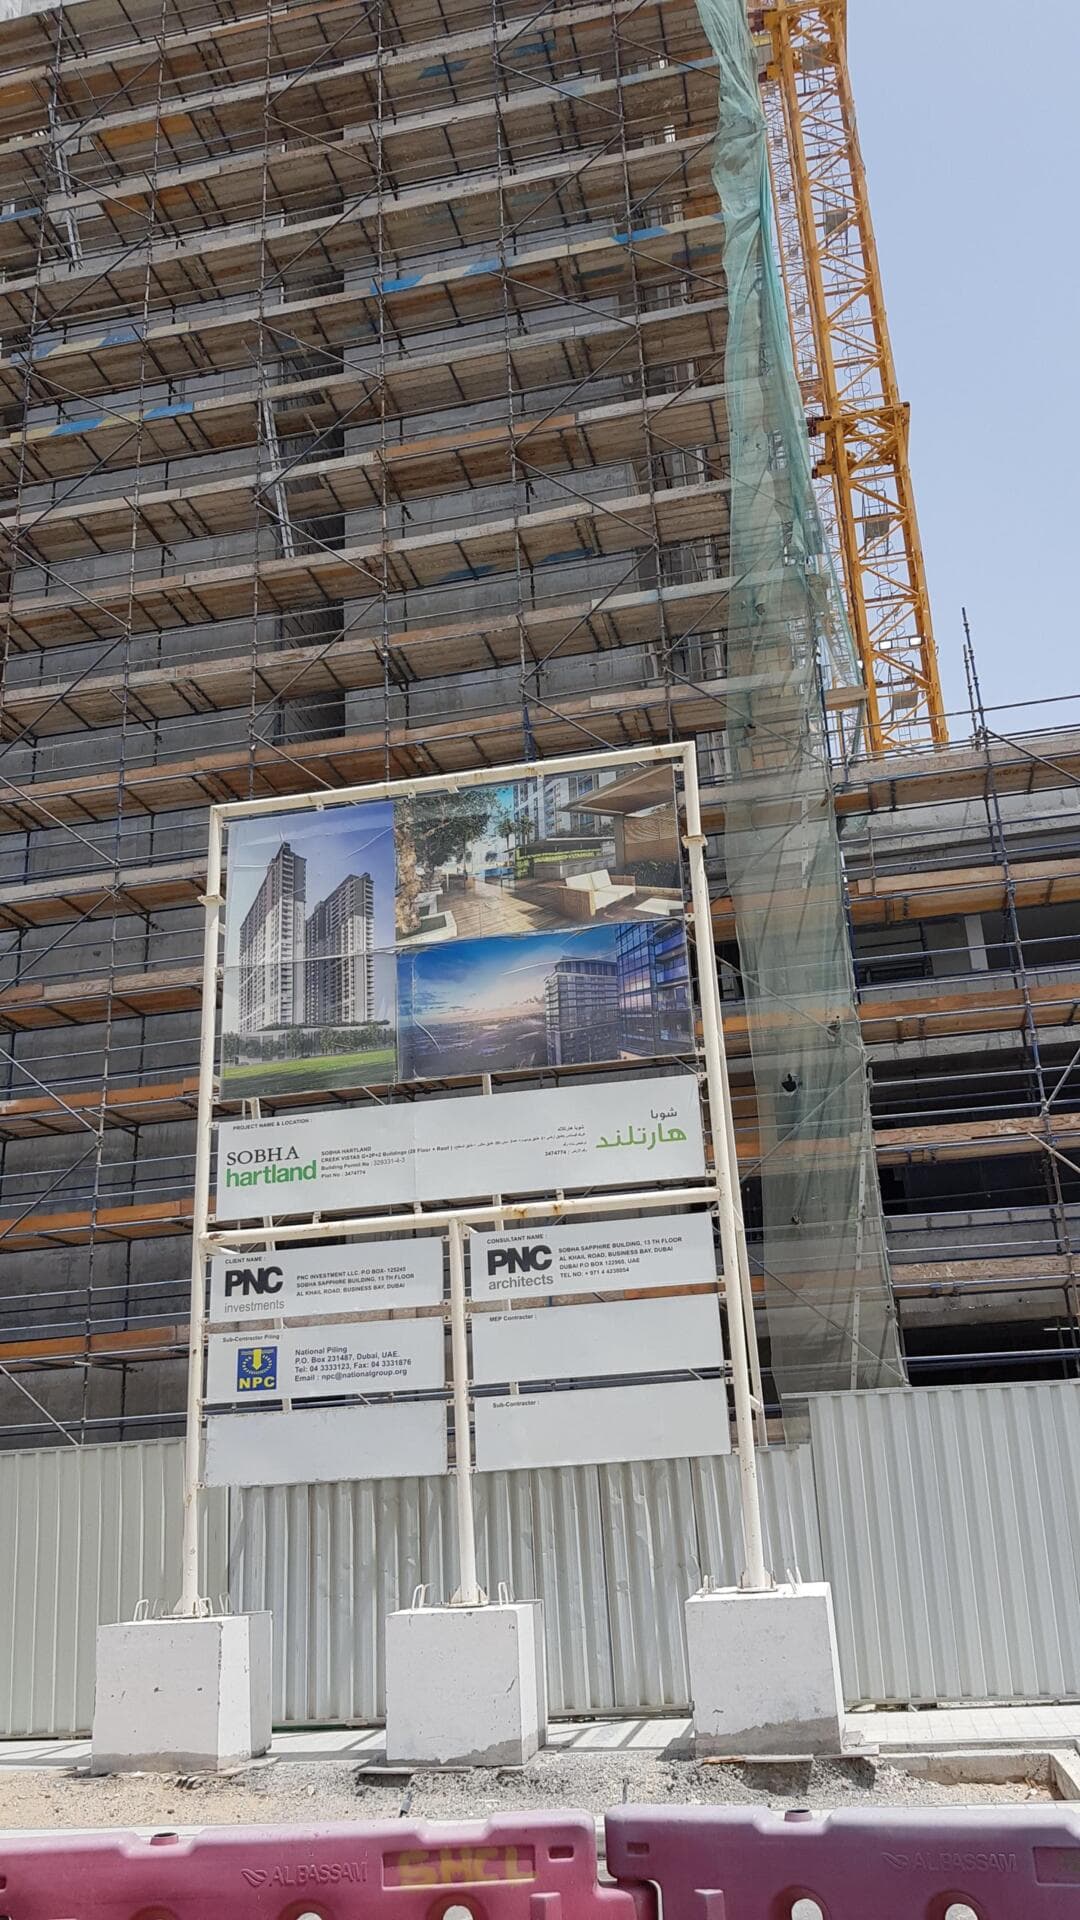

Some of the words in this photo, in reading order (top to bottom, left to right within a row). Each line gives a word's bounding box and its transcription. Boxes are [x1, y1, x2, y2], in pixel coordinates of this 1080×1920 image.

[227, 1146, 300, 1166] SOBHA
[226, 1160, 316, 1188] hartland
[487, 1236, 525, 1244] CONSULTANT
[581, 1243, 611, 1251] SAPPHIRE
[487, 1245, 552, 1276] PNC
[225, 1266, 283, 1297] PNC
[488, 1274, 554, 1290] architects
[224, 1300, 285, 1313] investments
[320, 1363, 352, 1371] 3333123,
[321, 1369, 407, 1380] npc@nationalgroup.org
[239, 1376, 275, 1389] NPC
